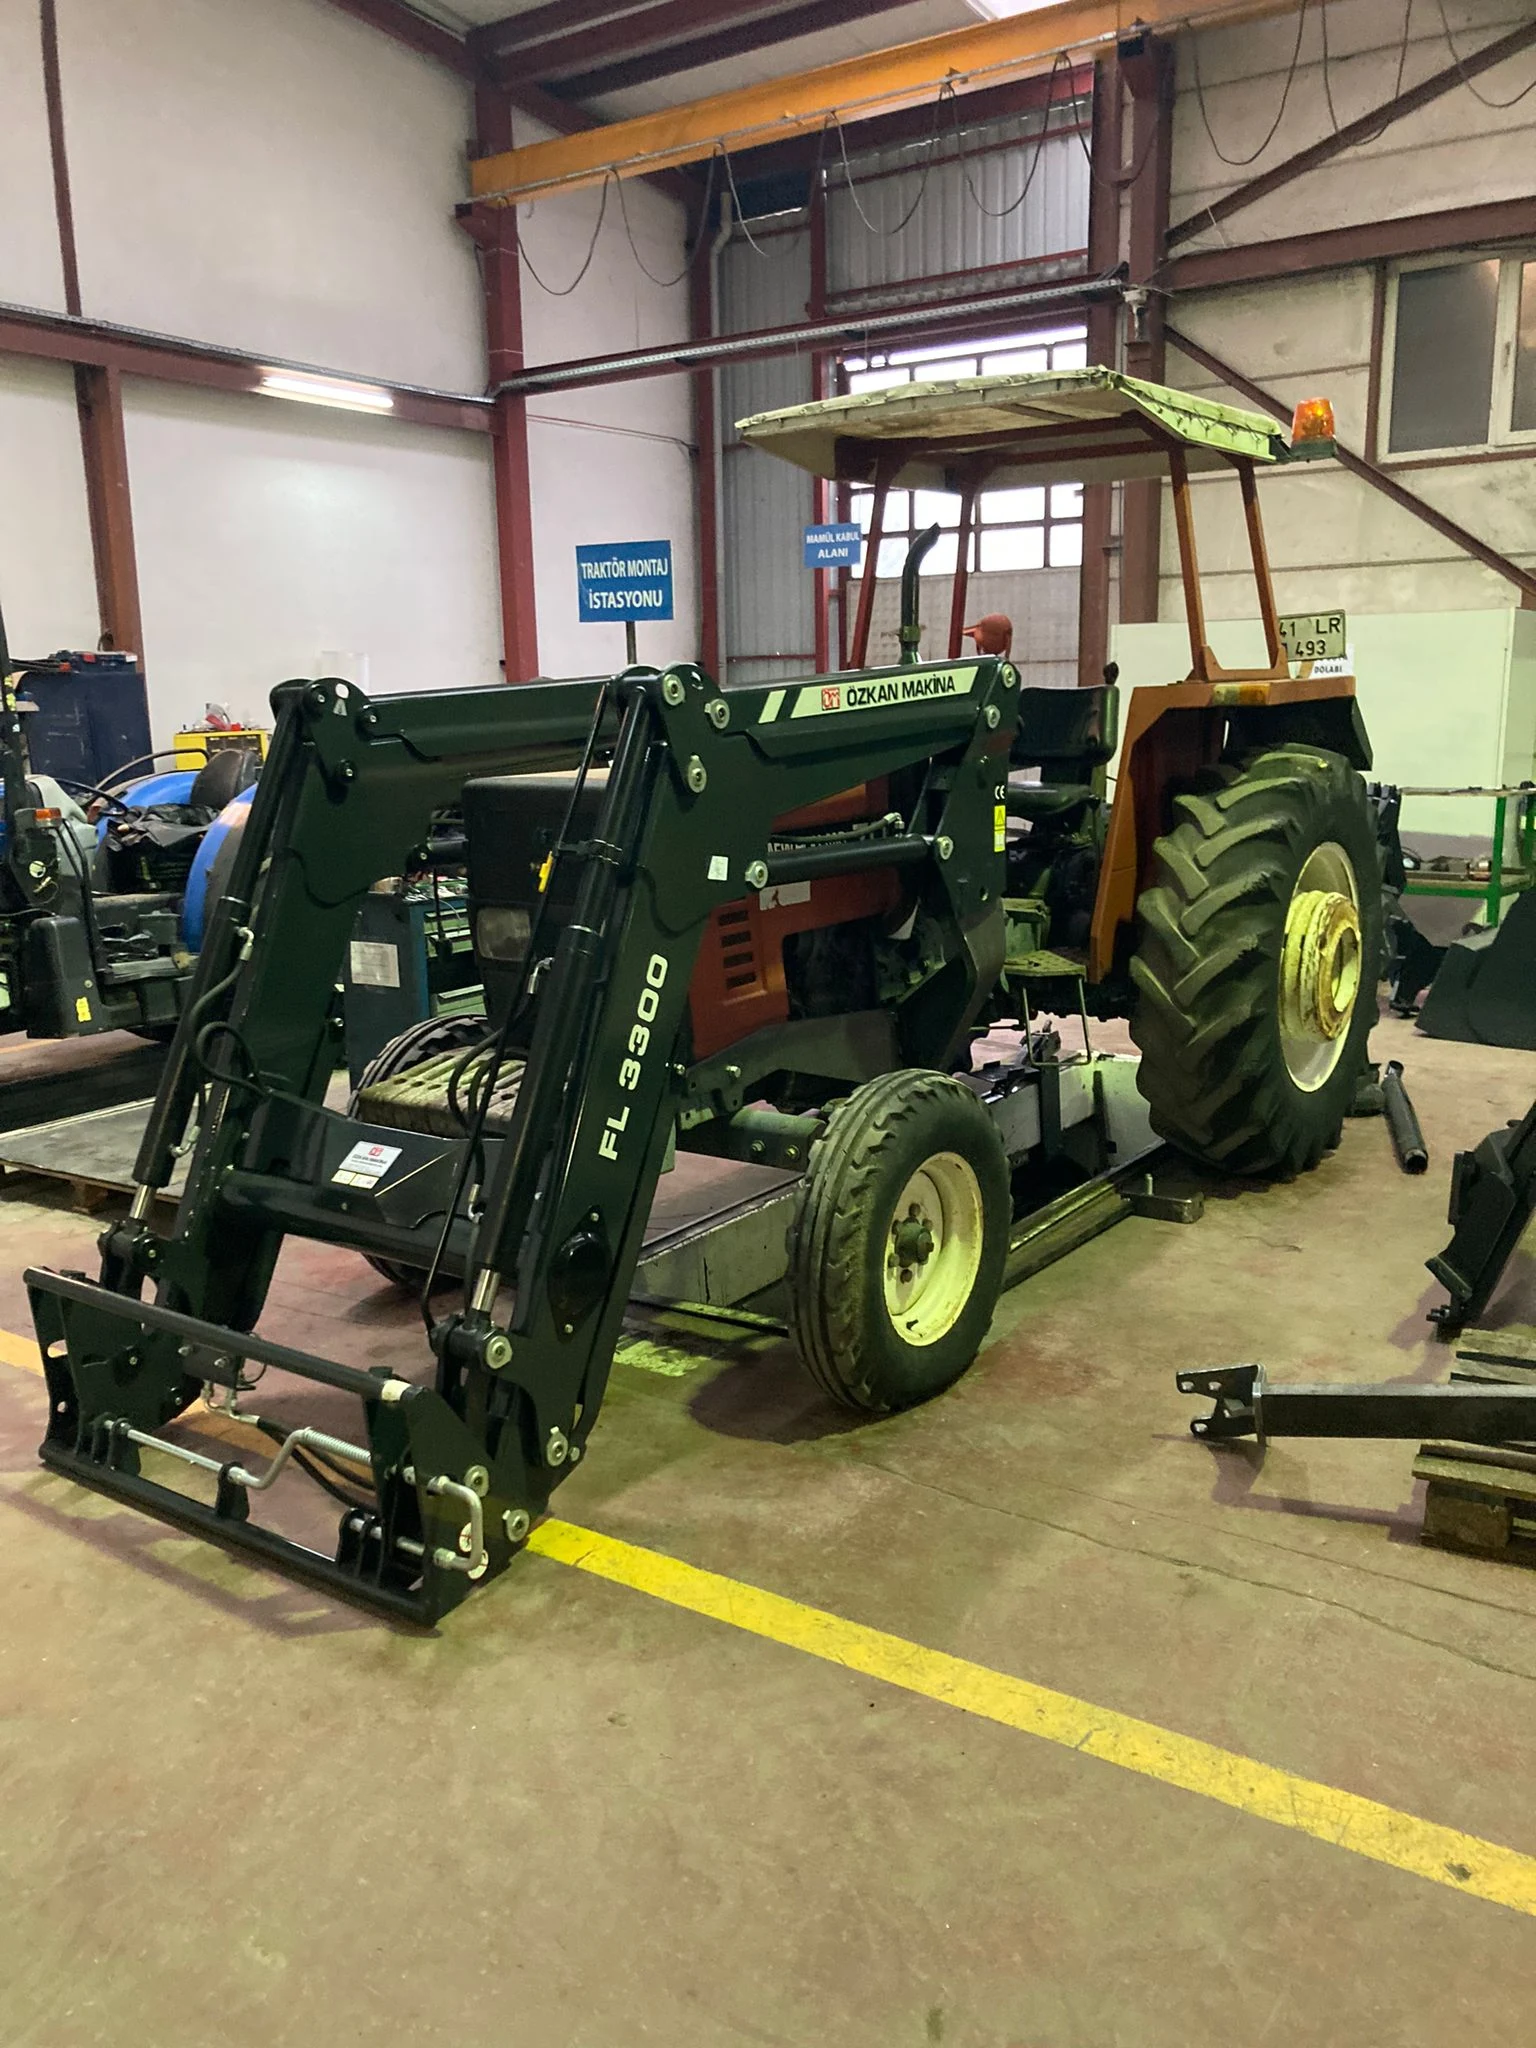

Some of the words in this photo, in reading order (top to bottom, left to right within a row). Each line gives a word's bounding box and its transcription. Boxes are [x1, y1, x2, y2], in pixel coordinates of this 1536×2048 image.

[806, 531, 835, 544] MAMÜL
[835, 531, 860, 542] KABUL
[818, 547, 849, 559] ALANI
[580, 556, 626, 580] TRAKTÖR
[627, 557, 668, 577] MONTAJ
[588, 588, 663, 609] İSTASYONU
[1315, 617, 1341, 635] LR
[1295, 639, 1326, 657] 493
[1314, 665, 1343, 674] DOLABI
[846, 682, 899, 707] ÖZKAN
[901, 673, 956, 699] MAKİNA
[598, 1106, 630, 1161] FL
[618, 953, 668, 1091] 3300
